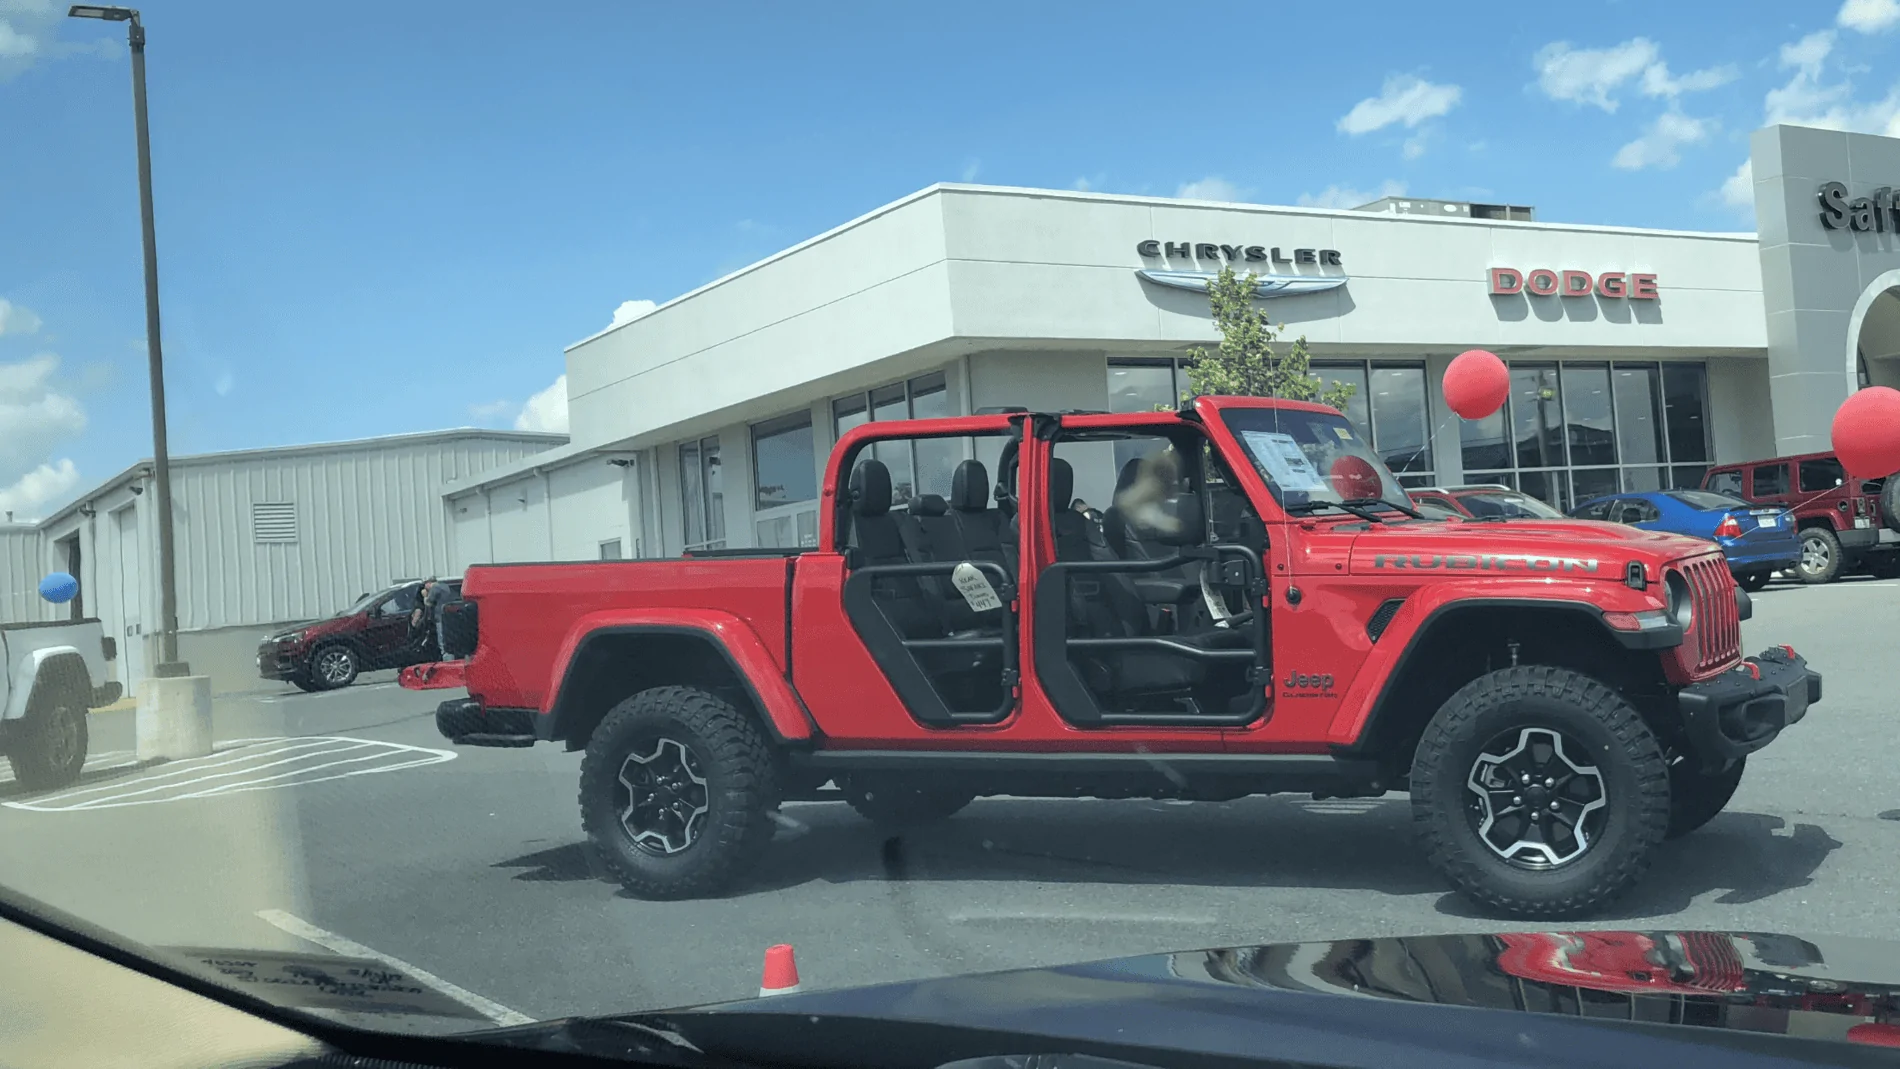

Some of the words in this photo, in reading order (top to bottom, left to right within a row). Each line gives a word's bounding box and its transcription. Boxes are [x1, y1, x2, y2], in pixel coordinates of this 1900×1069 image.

[1818, 181, 1900, 233] Saf
[1137, 240, 1343, 266] CHRYSLER
[1486, 267, 1659, 300] DODGE
[1375, 554, 1599, 573] RUBICON
[1283, 669, 1335, 691] Jeep
